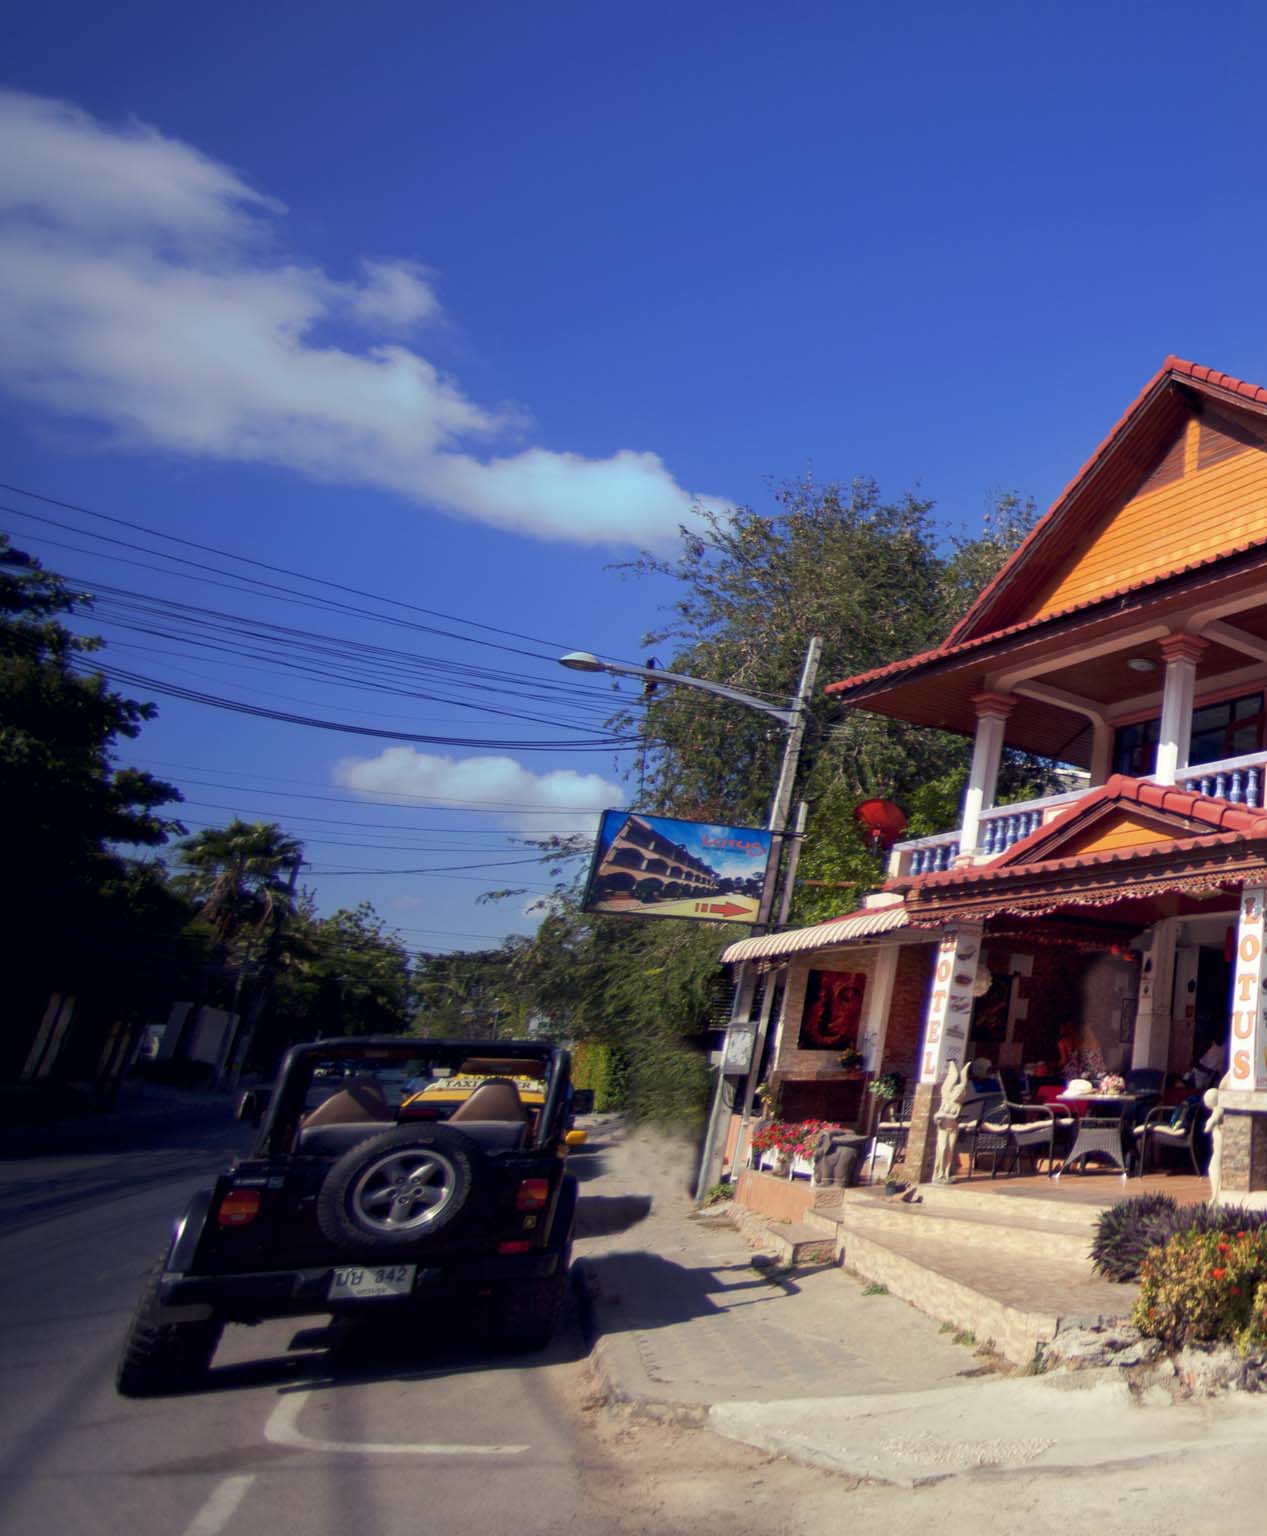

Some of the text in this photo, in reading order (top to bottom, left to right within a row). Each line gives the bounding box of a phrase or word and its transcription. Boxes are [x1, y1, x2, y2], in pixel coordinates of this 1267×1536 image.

[925, 937, 955, 1074] HOTEL
[1233, 897, 1262, 1079] LOTUS
[445, 1080, 478, 1089] TAXI
